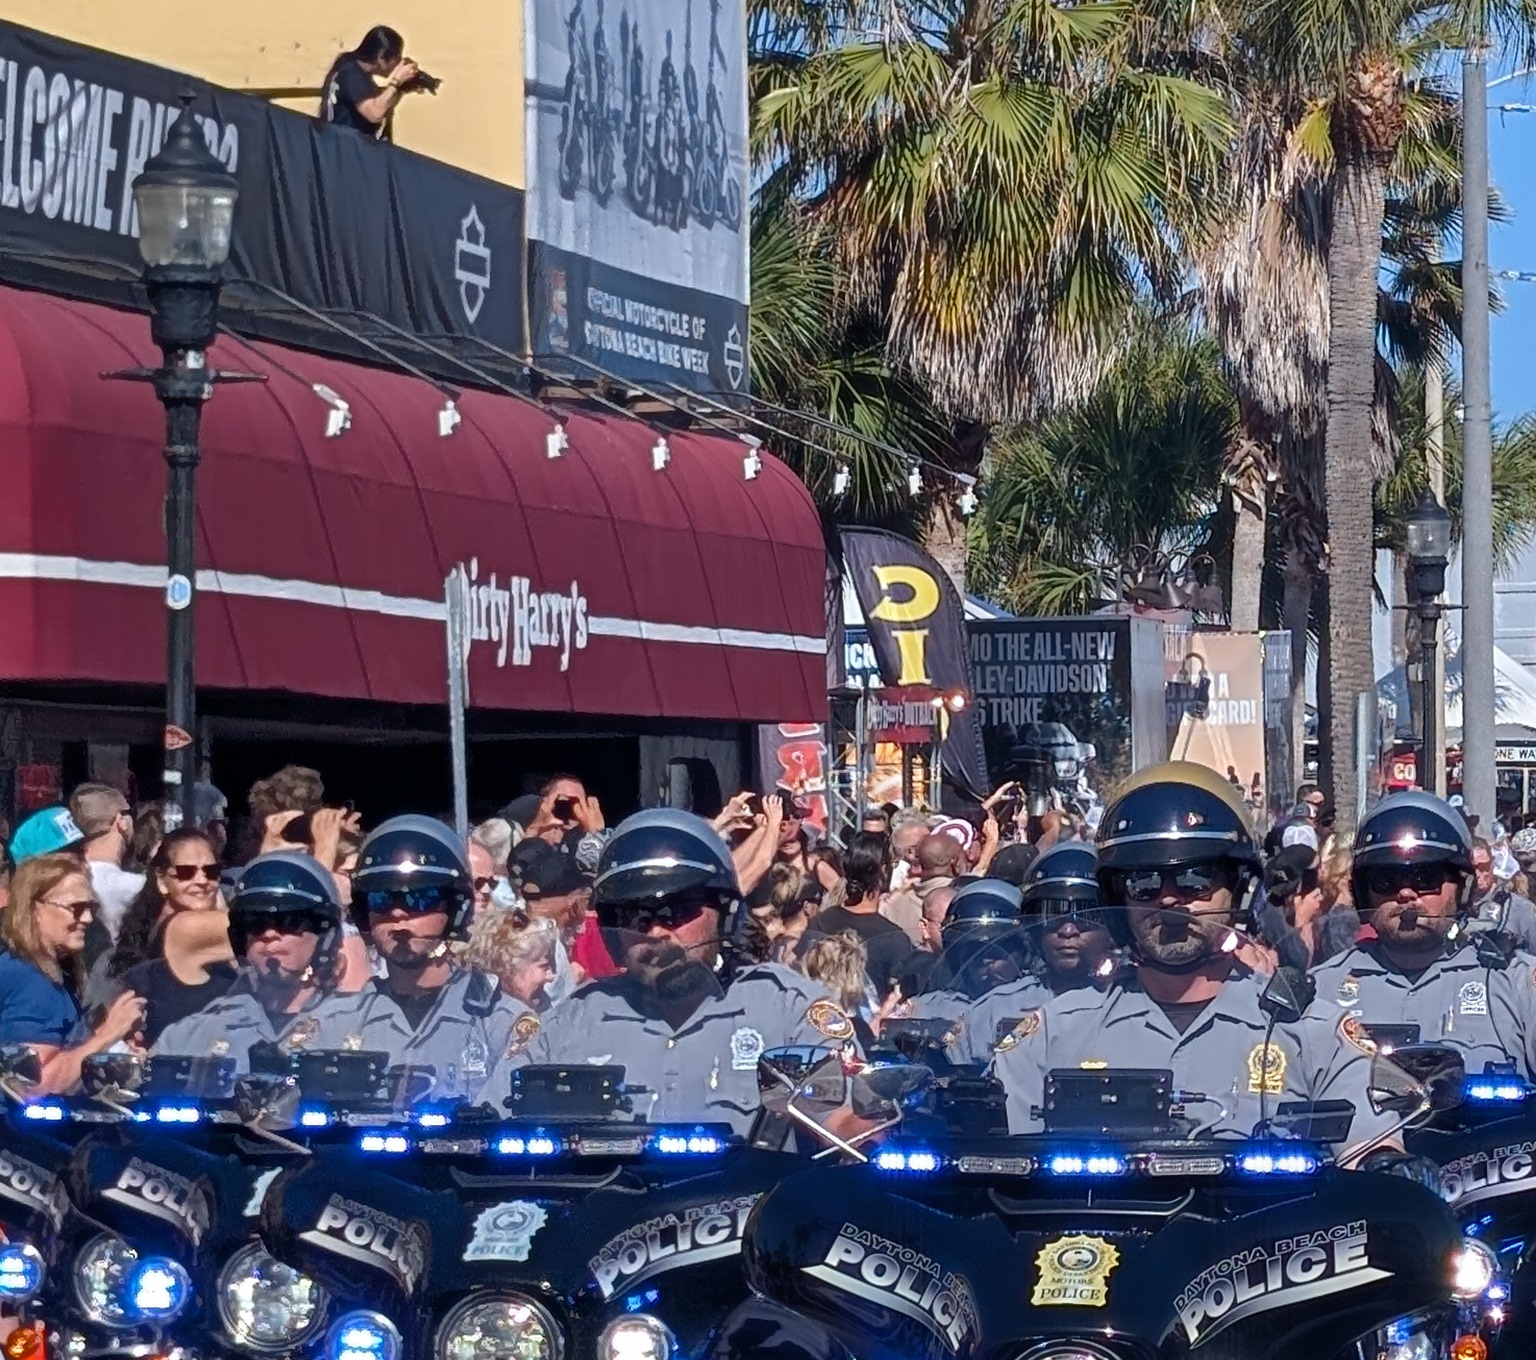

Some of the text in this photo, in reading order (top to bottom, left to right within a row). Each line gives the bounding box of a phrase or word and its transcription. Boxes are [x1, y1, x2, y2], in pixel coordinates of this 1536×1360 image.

[692, 316, 706, 340] OF
[657, 340, 681, 368] BIKE
[681, 346, 709, 375] WEEK
[511, 575, 588, 672] Harry's
[994, 633, 1031, 661] THE
[1034, 631, 1116, 660] ALL-NEW
[989, 697, 1043, 726] TRIKE
[1208, 700, 1257, 725] CARD!
[840, 1222, 941, 1278] DAYTONA
[1173, 1220, 1367, 1314] DAYTONA BEACH
[824, 1235, 969, 1351] POLICE
[1040, 1288, 1101, 1300] POLICE
[1180, 1233, 1369, 1344] POLICE
